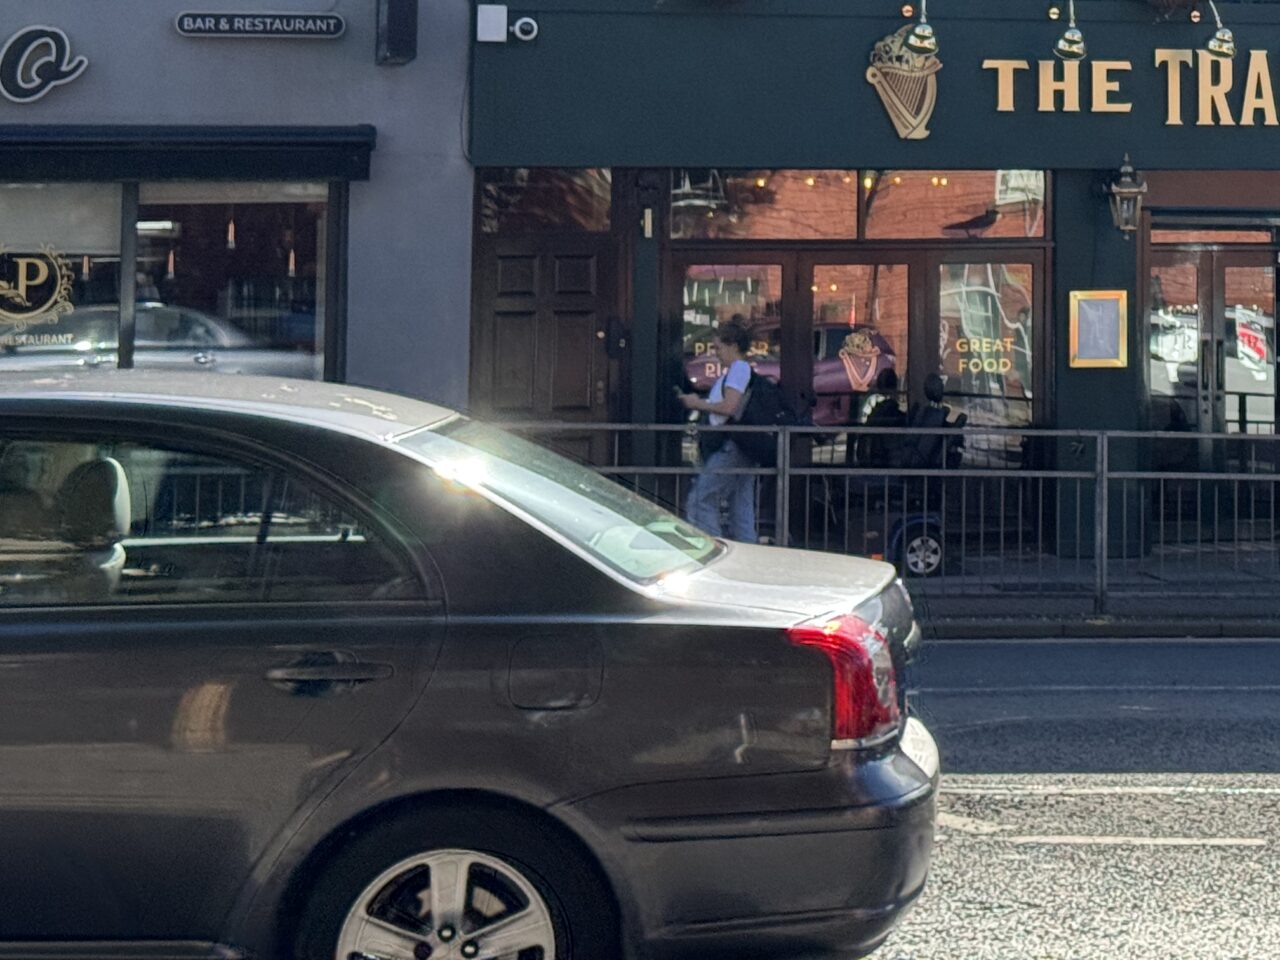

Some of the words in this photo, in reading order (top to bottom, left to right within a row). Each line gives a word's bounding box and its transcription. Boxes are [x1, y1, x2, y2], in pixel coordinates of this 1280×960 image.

[183, 17, 215, 30] BAR
[219, 19, 230, 30] &
[234, 19, 337, 32] RESTAURANT
[982, 58, 1133, 112] THE
[956, 337, 1014, 353] GREAT
[958, 358, 1012, 373] FOOD
